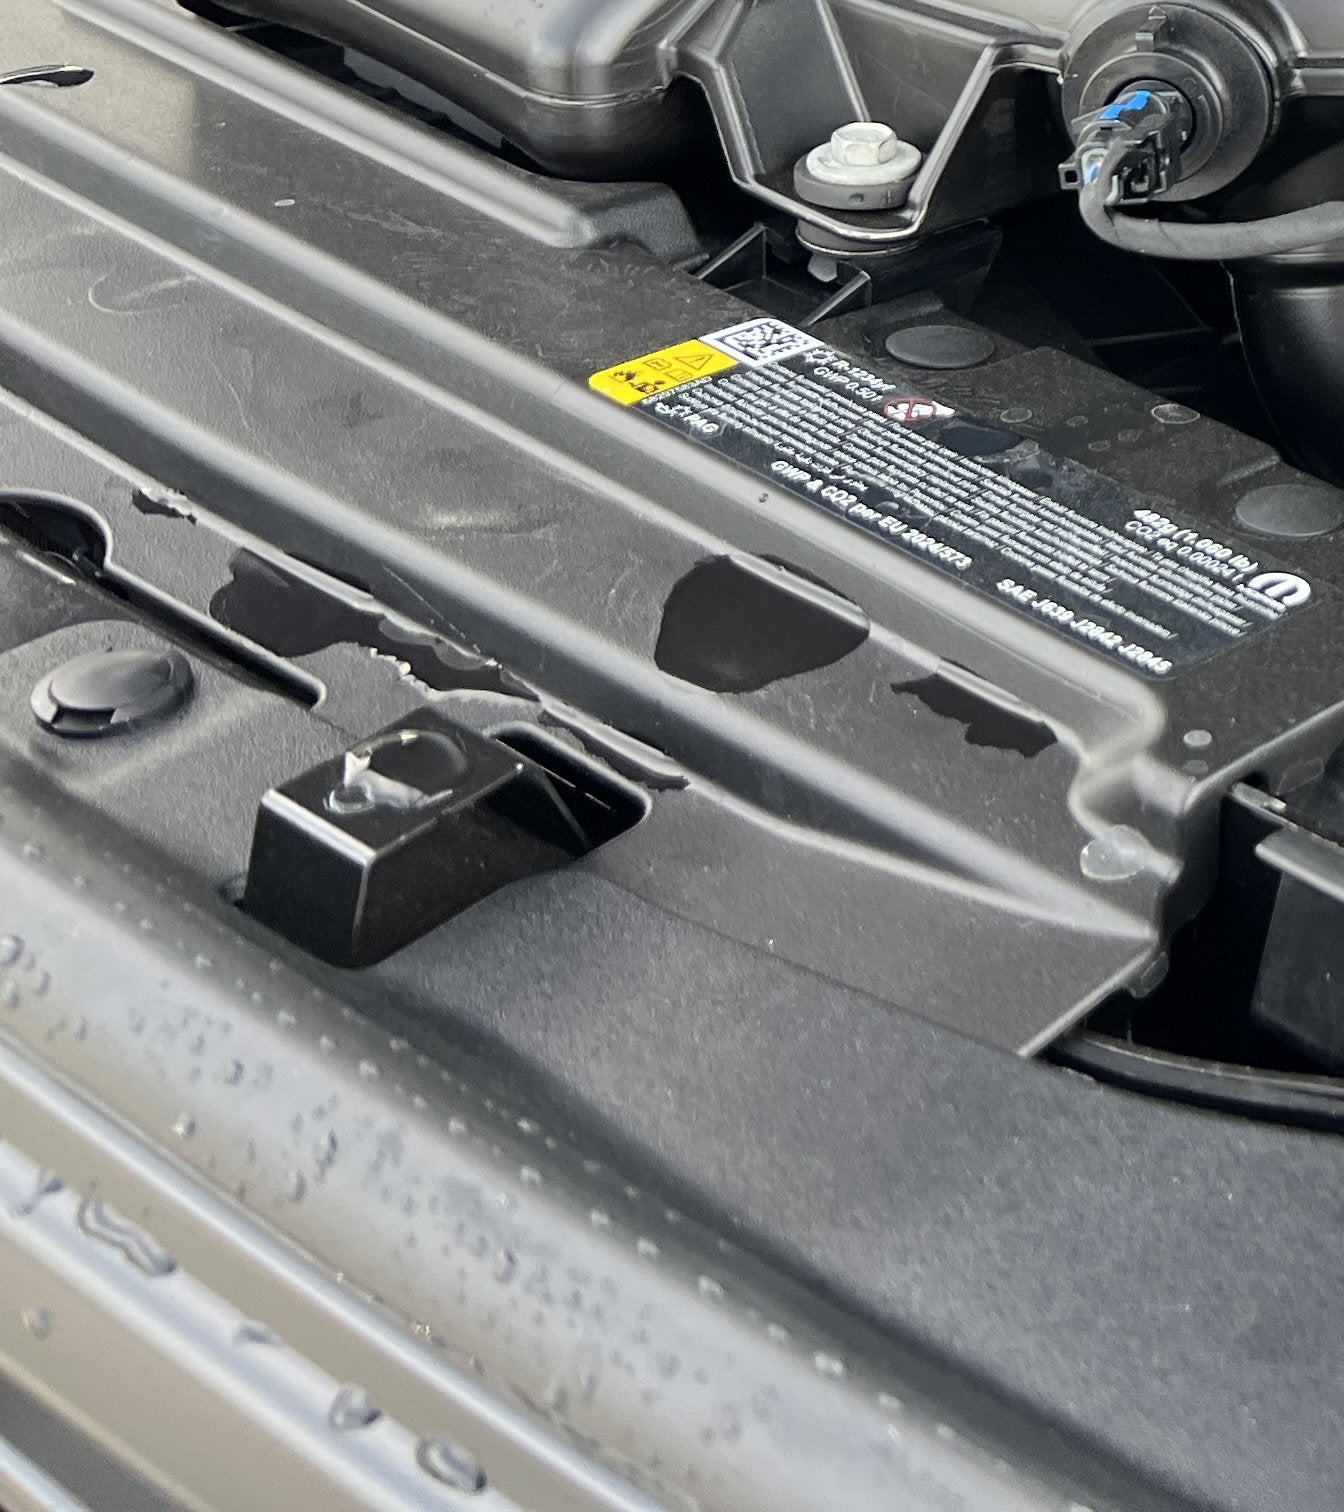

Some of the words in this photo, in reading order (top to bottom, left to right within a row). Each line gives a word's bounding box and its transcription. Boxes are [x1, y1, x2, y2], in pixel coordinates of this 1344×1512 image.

[813, 366, 851, 384] GWP
[845, 381, 884, 403] 0.501
[832, 359, 897, 392] R-1234yf
[683, 413, 720, 433] PAG
[770, 459, 812, 483] GWP
[805, 479, 824, 494] &
[821, 484, 857, 507] CO2
[849, 502, 883, 522] per
[877, 515, 908, 536] EU
[901, 528, 973, 571] 2024/573
[1133, 509, 1179, 537] 482g
[1228, 554, 1259, 576] lb)
[1124, 520, 1162, 544] CO2
[1156, 537, 1179, 555] eq
[1176, 545, 1237, 580] 0.00024
[996, 578, 1038, 605] SAE
[1031, 598, 1076, 625] J639
[1069, 618, 1124, 650] J2842
[1117, 643, 1173, 675] J2845
